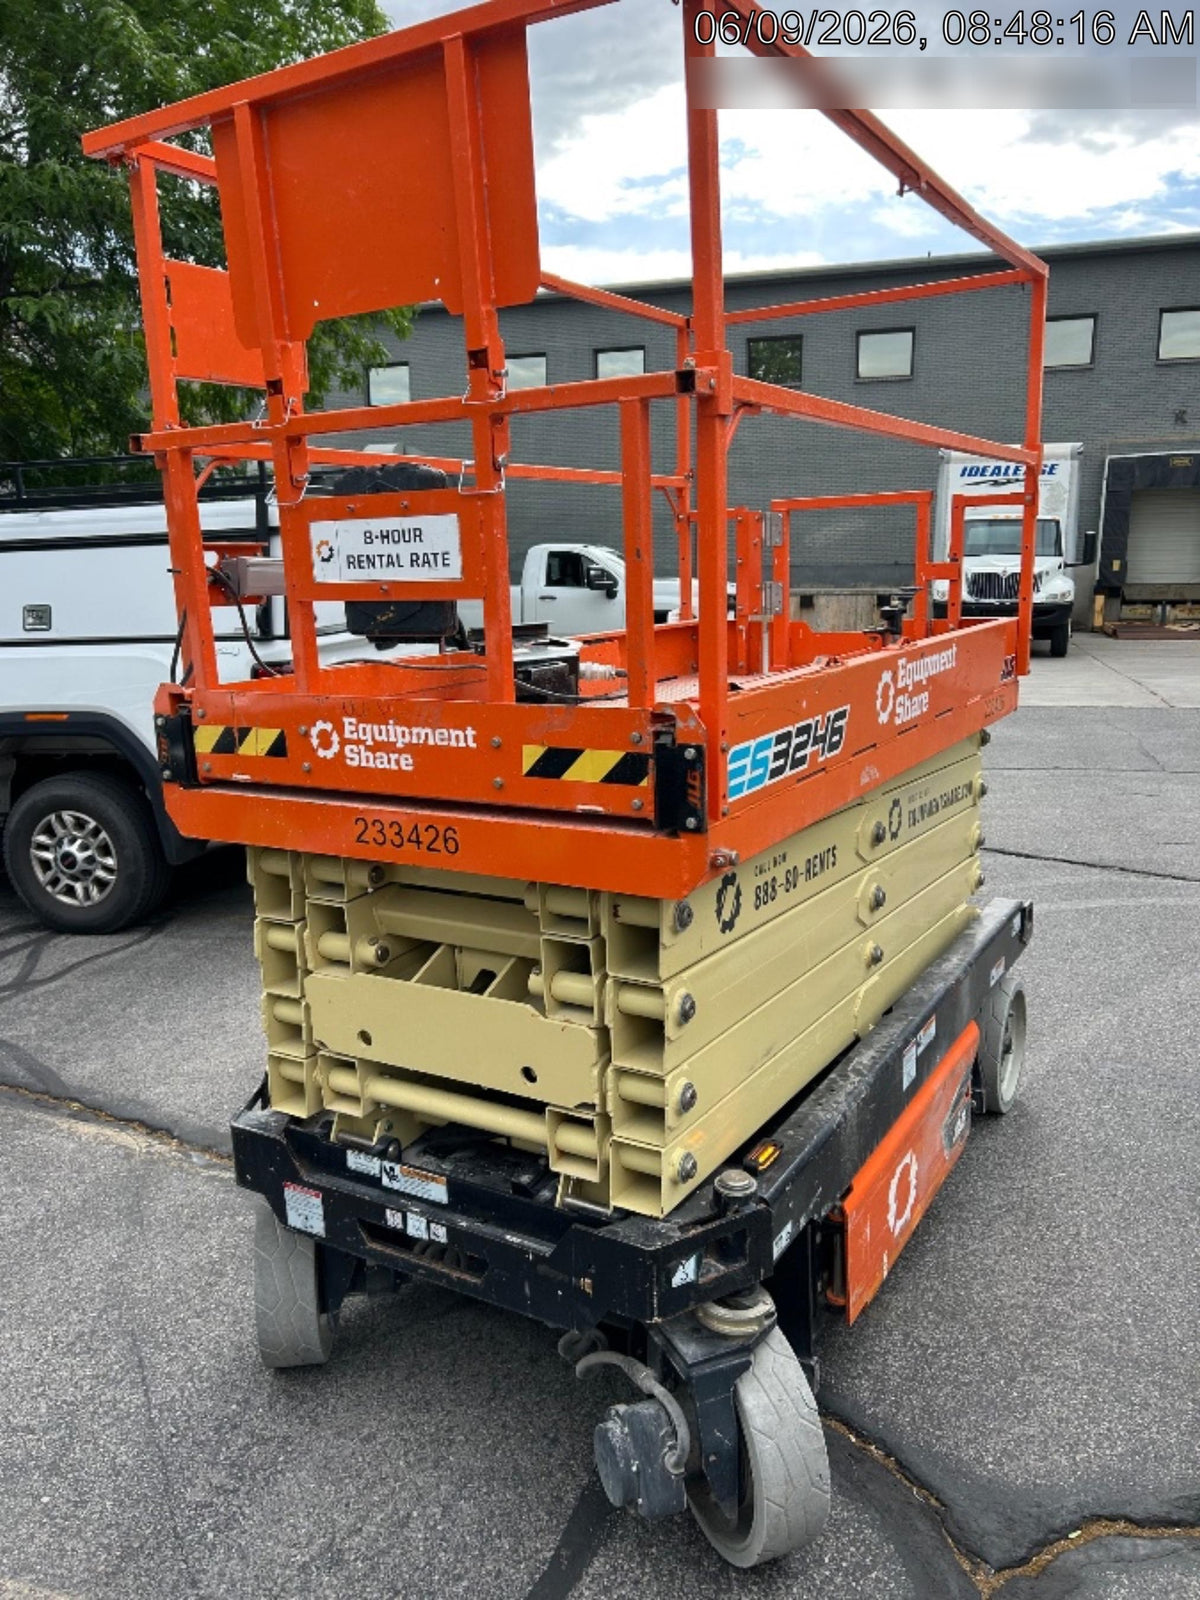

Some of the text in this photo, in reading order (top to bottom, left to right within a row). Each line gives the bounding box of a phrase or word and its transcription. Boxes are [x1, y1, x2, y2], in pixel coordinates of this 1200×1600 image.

[960, 463, 1060, 477] IDEALESE
[363, 527, 424, 545] 8-HOUR
[346, 551, 451, 570] RENTAL RATE
[897, 643, 957, 692] Equipment
[894, 690, 929, 726] Share
[342, 716, 477, 749] Equipment
[344, 744, 414, 771] Share
[727, 704, 851, 803] ES3246
[354, 817, 460, 855] 233426
